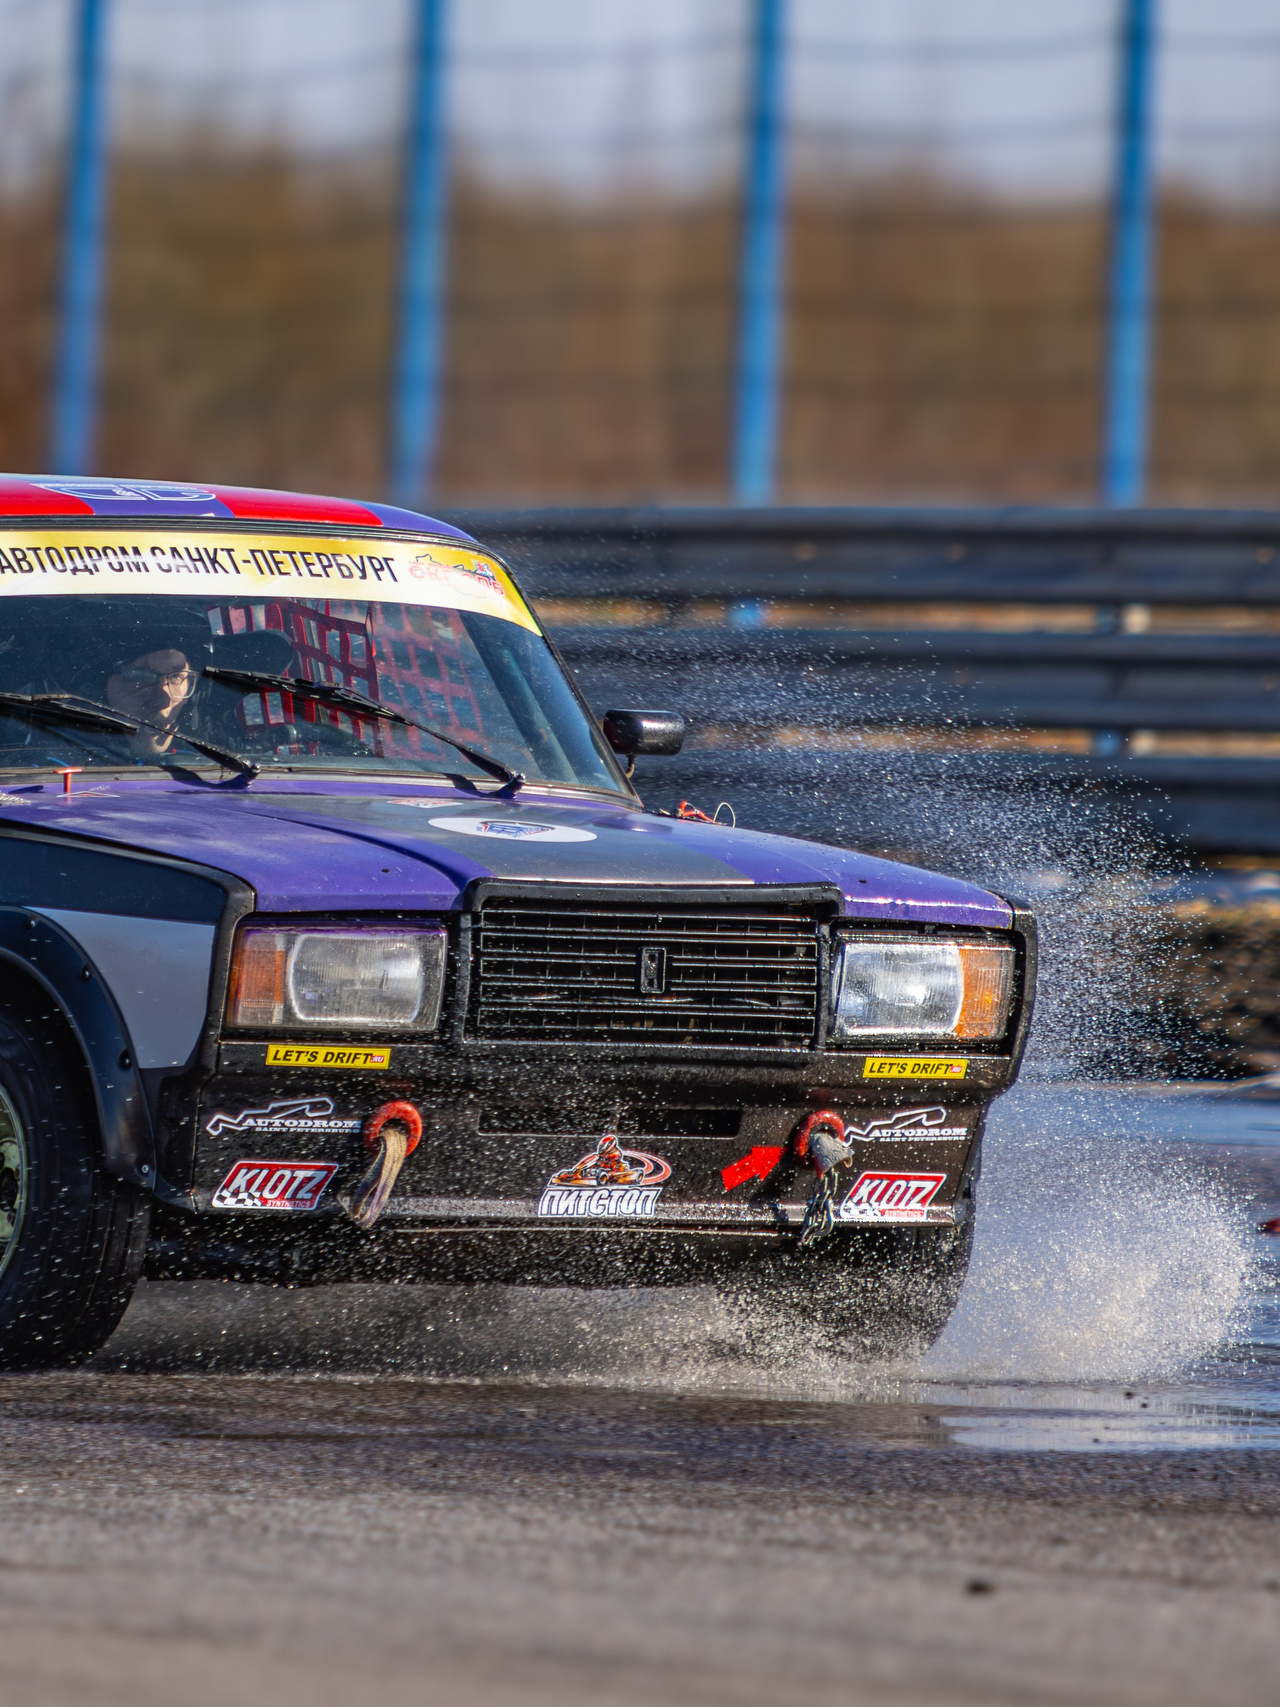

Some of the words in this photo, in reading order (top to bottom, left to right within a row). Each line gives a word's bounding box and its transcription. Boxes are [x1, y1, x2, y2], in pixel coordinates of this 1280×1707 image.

[150, 546, 399, 583] САНКТ-ПЕТЕРБУРГ
[272, 1050, 319, 1064] LET'S
[869, 1062, 908, 1074] LET'S
[242, 1118, 362, 1128] AUTODROM
[869, 1128, 967, 1137] AUTODROM
[230, 1168, 327, 1200] KLOTZ
[853, 1179, 937, 1209] KLOTZ
[266, 1200, 311, 1208] SYNTHETICS
[541, 1187, 659, 1216] ПИТСТОП
